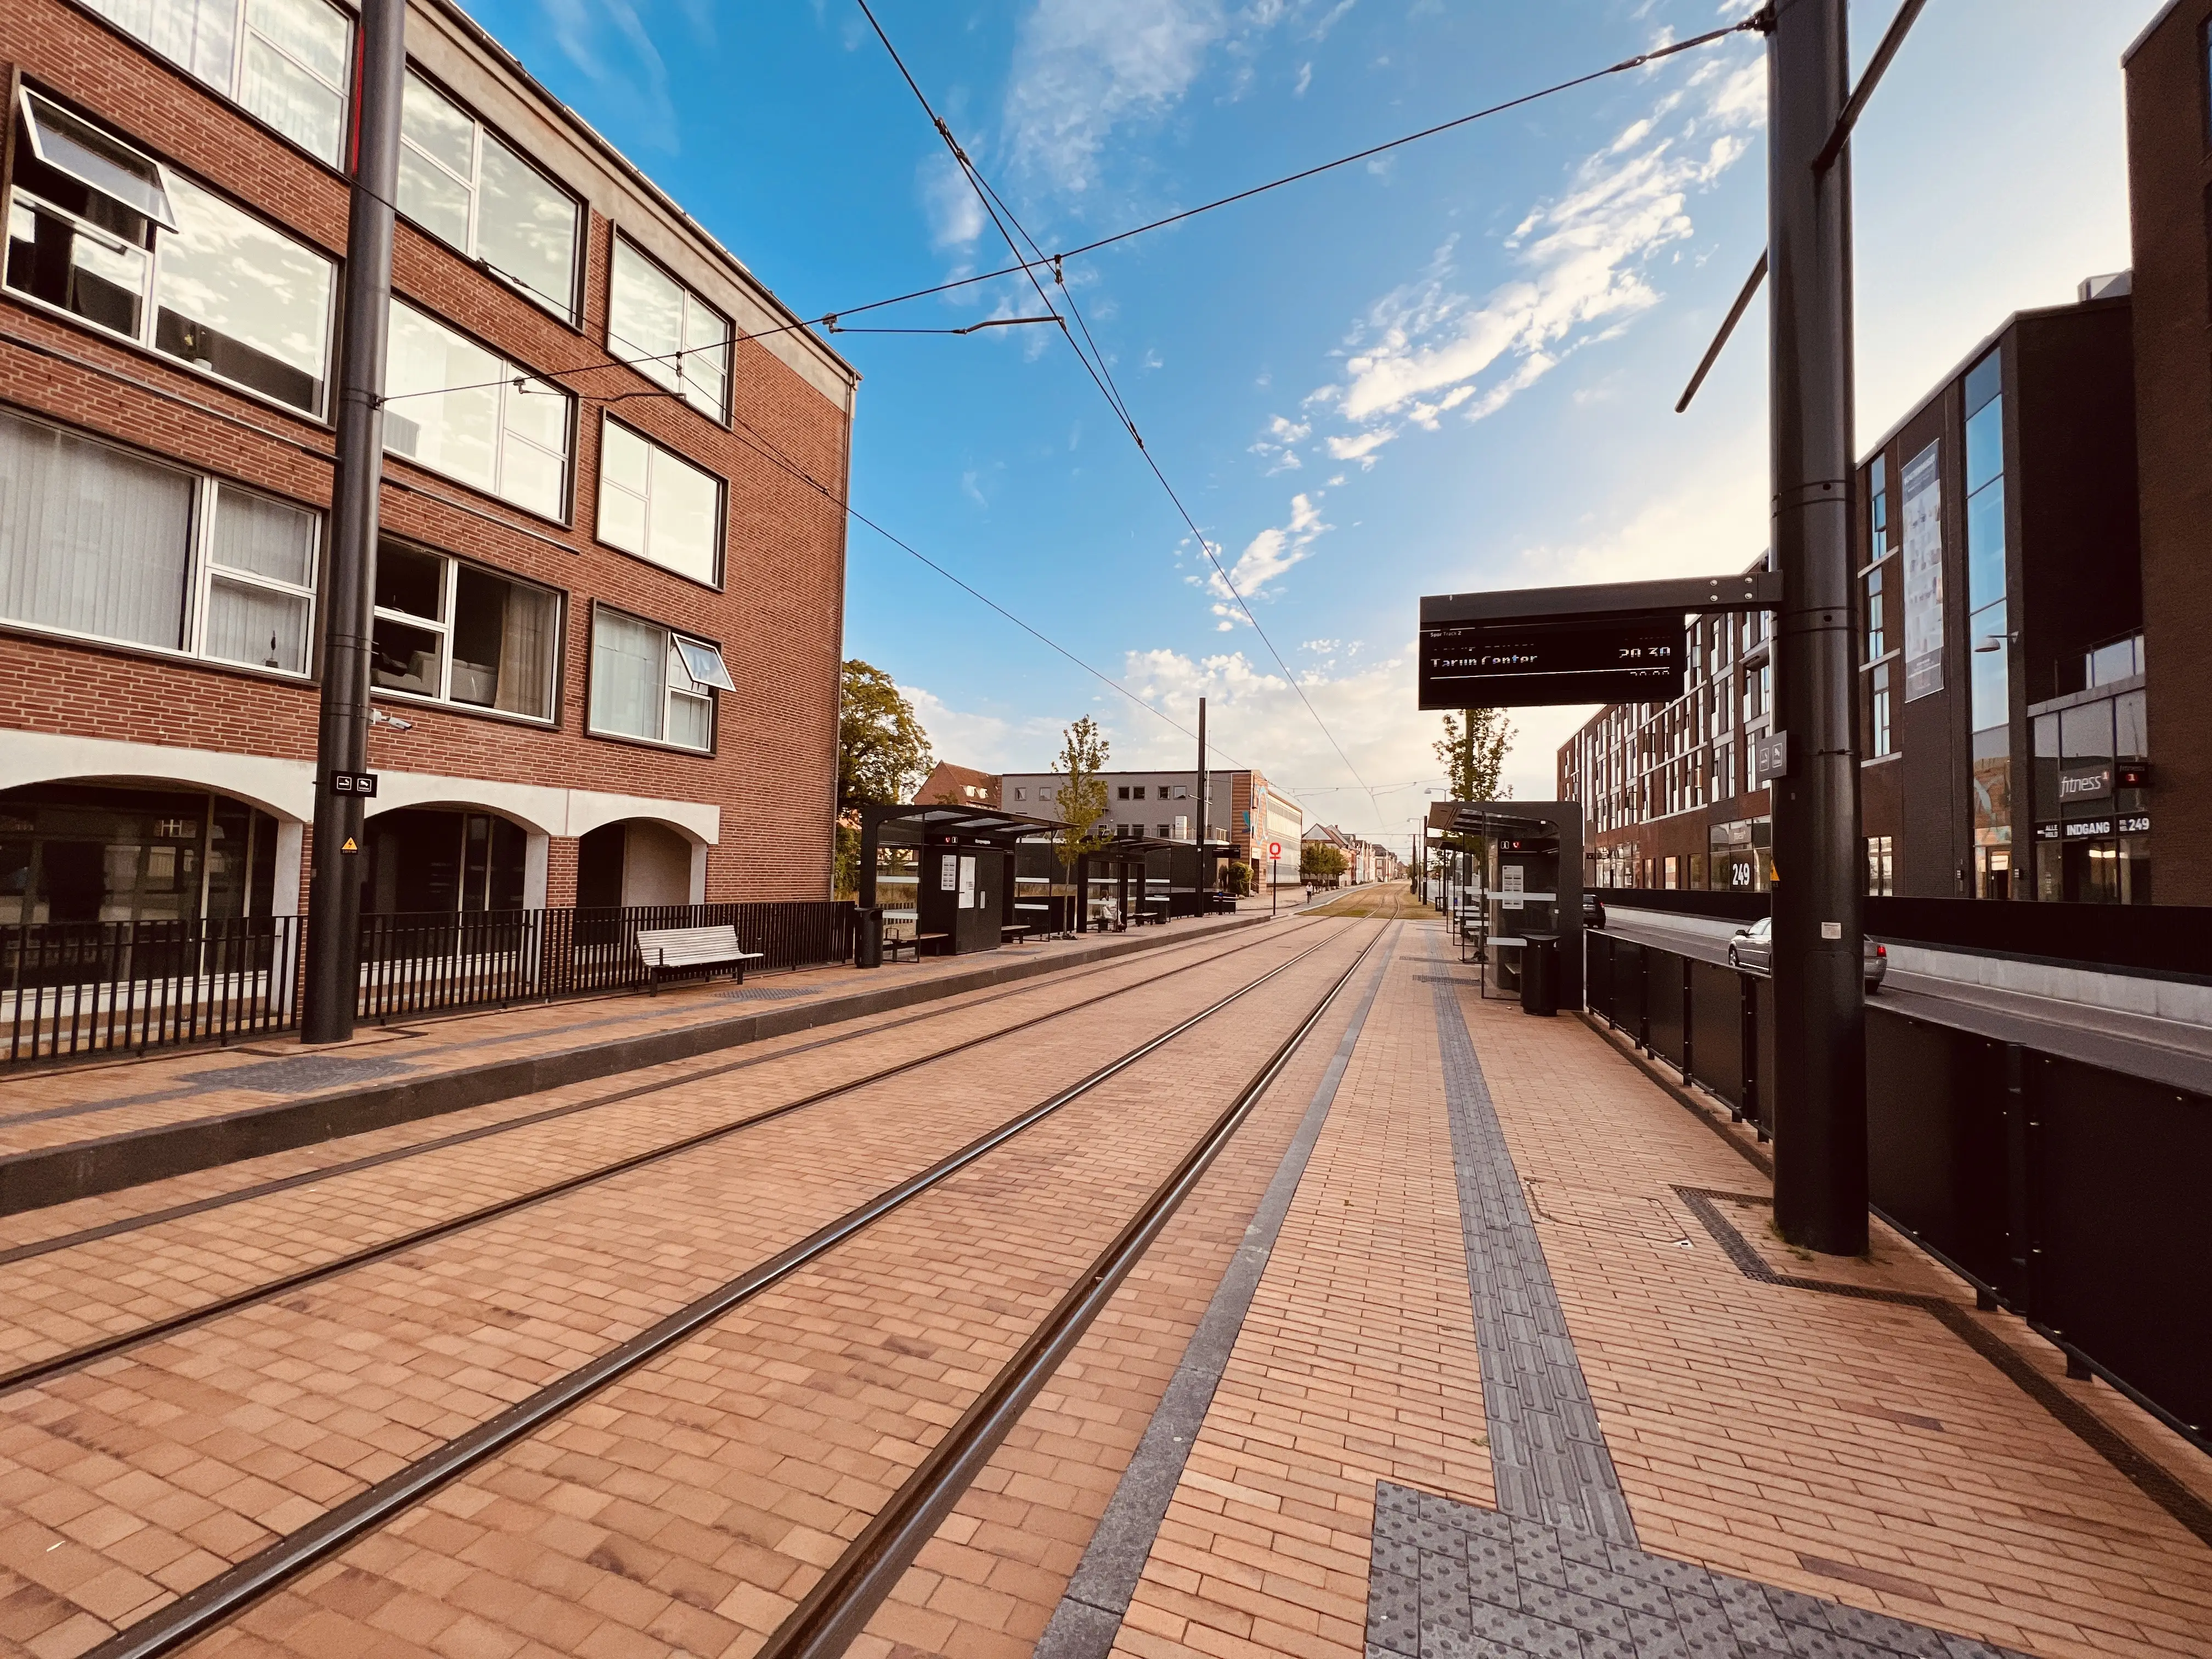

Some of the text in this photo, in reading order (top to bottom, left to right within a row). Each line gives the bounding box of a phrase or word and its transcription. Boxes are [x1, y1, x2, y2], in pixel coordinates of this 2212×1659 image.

[2066, 821, 2111, 836] INDGANG
[2129, 817, 2149, 831] 249
[1733, 862, 1750, 885] 249
